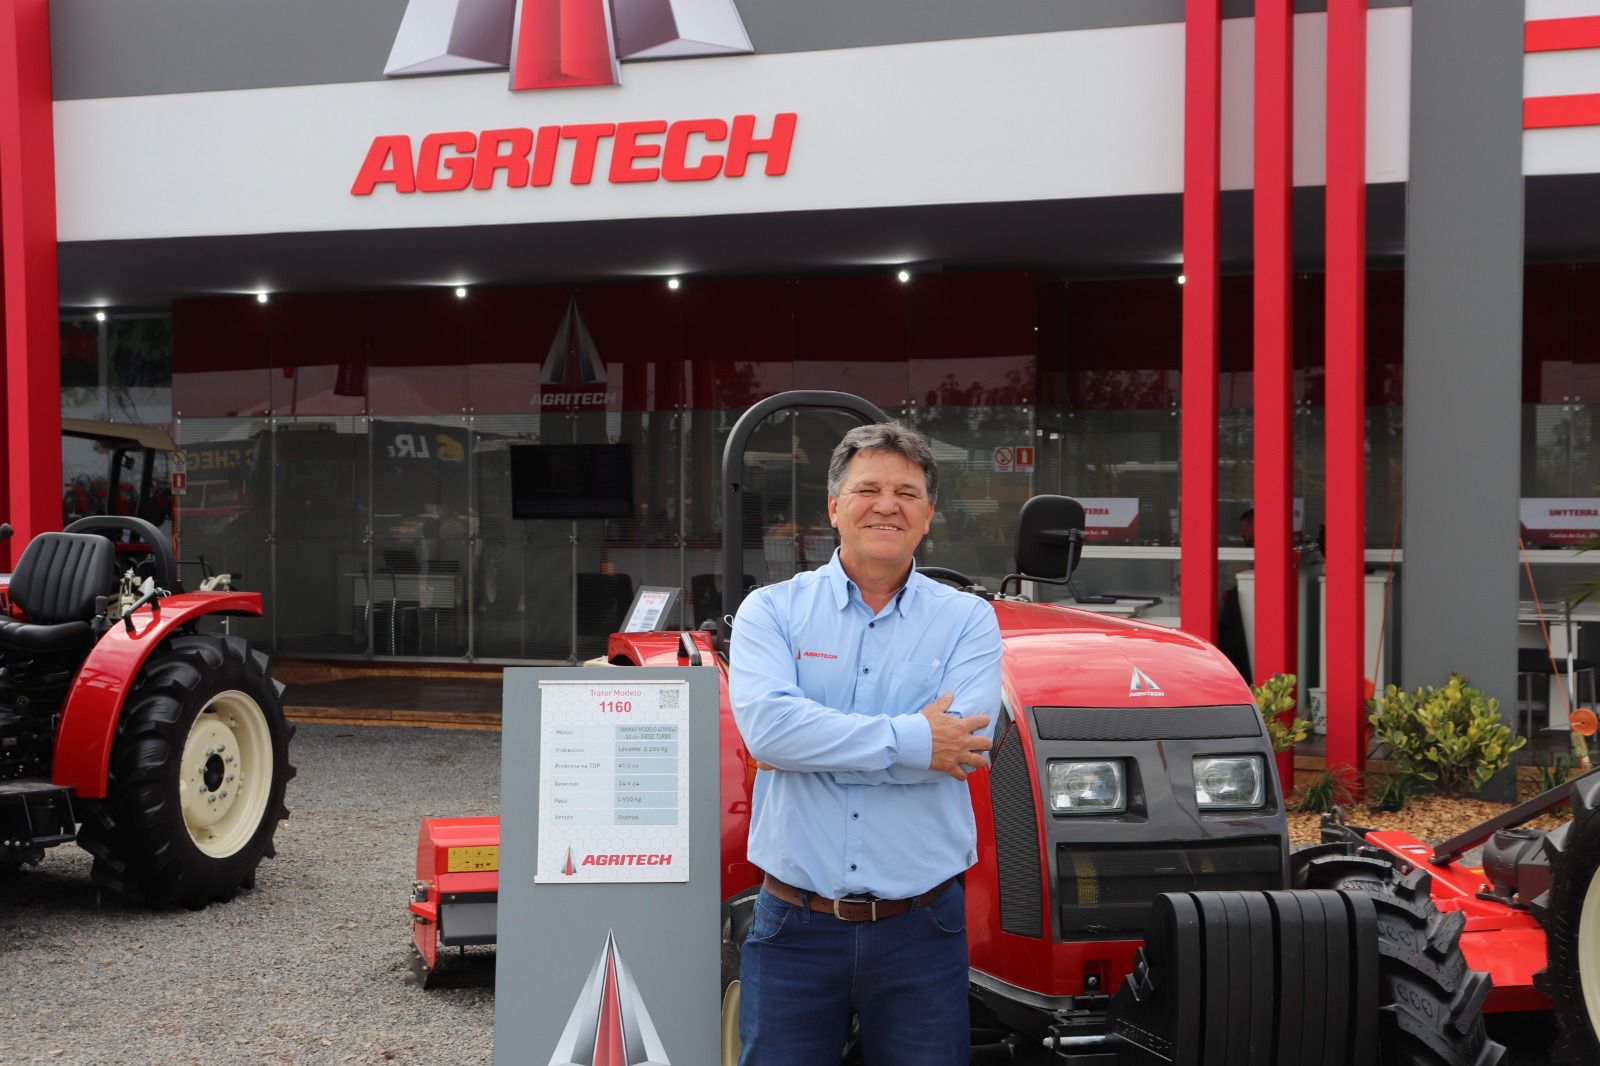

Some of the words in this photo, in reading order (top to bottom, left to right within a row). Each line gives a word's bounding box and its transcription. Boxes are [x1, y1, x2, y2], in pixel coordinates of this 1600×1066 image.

[350, 112, 798, 196] AGRITECH
[528, 392, 617, 406] AGRITECH
[804, 651, 838, 659] AGRITECH
[613, 689, 642, 697] Modelo
[599, 701, 632, 713] 1160
[581, 854, 673, 866] AGRITECH
